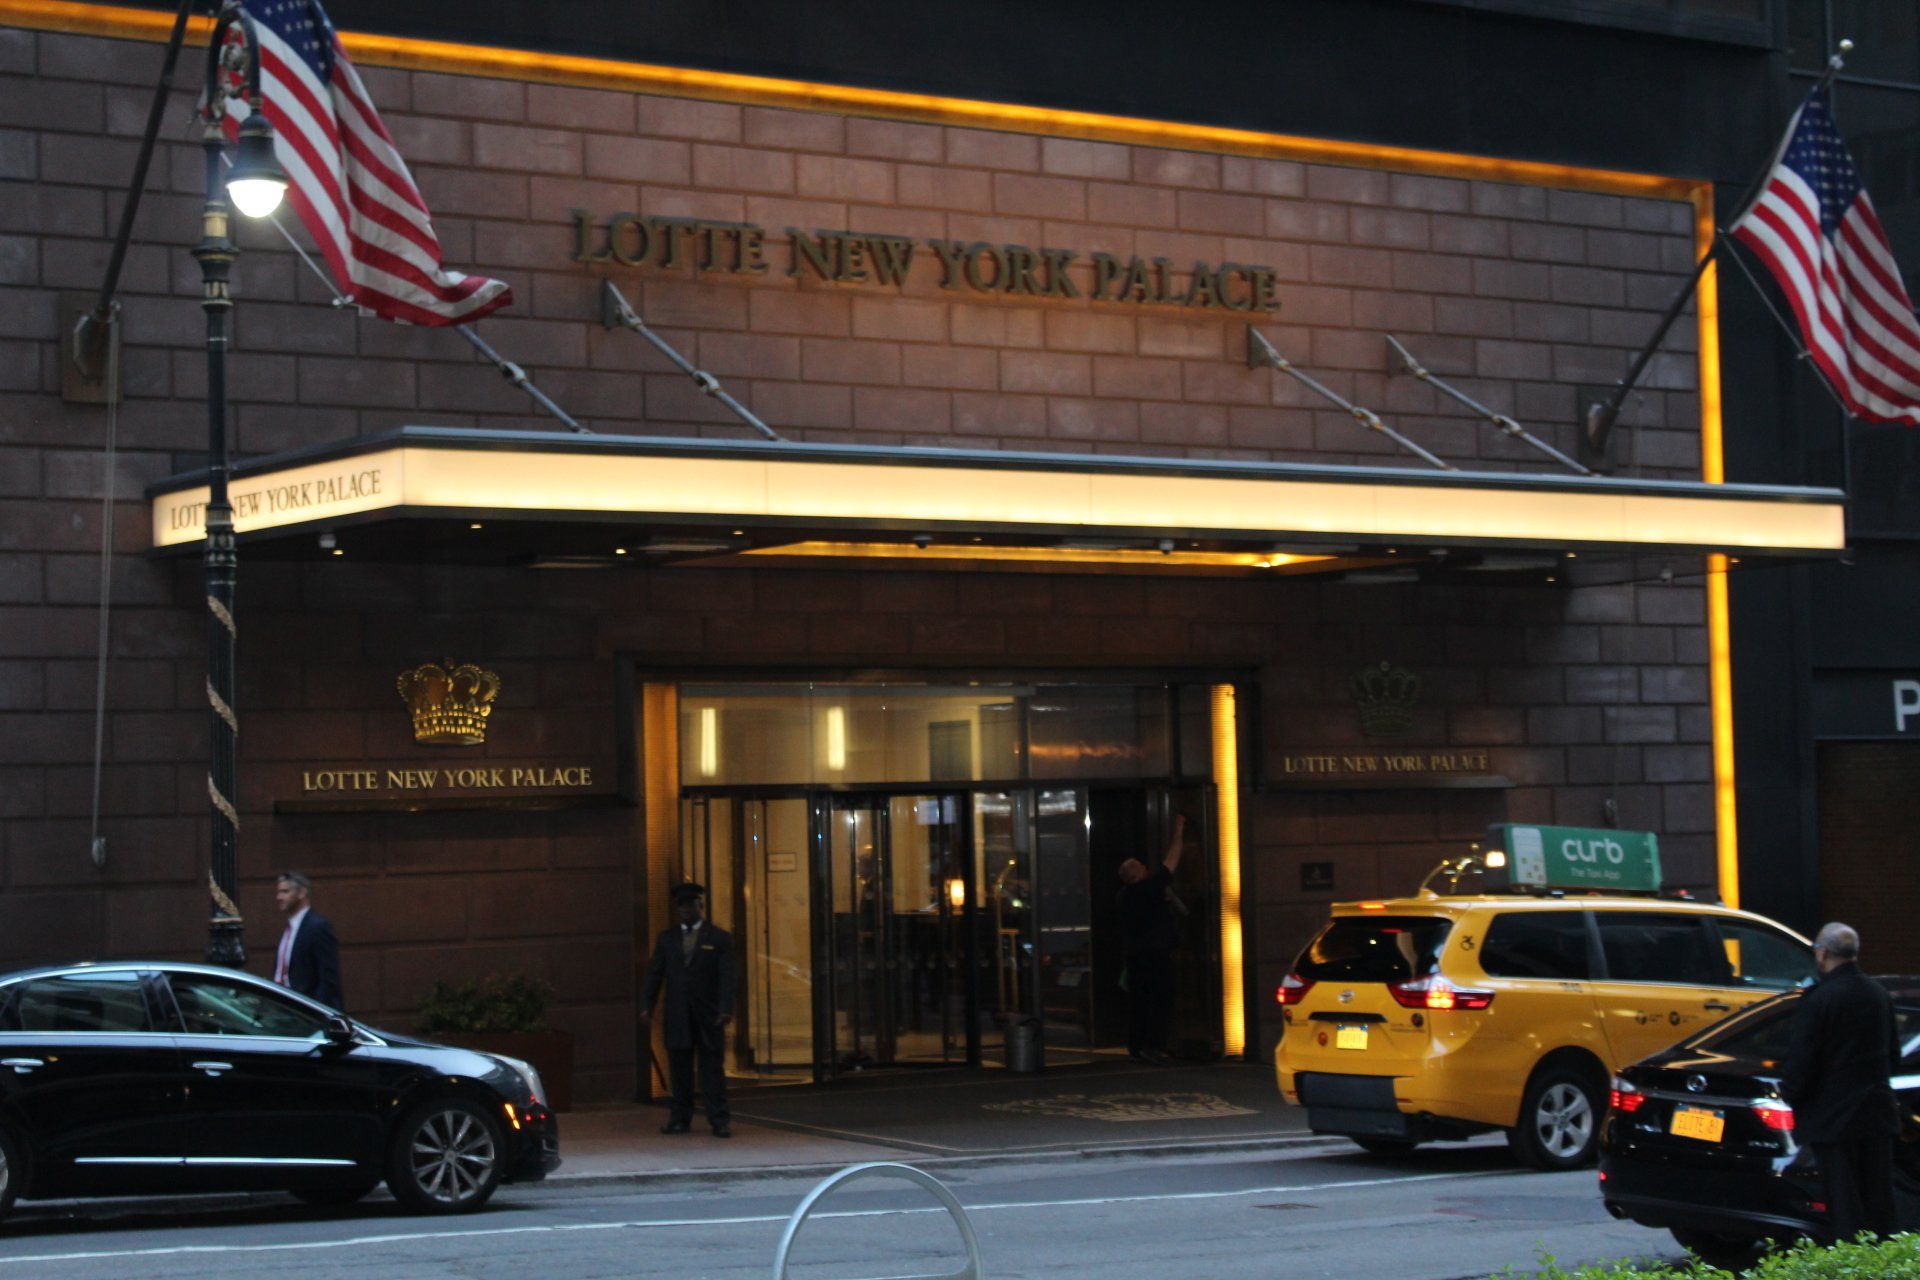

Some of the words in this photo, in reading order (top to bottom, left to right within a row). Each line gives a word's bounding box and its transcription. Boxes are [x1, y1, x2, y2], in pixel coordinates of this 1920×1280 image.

[572, 209, 769, 275] LOTTE
[785, 226, 917, 287] NEW
[926, 239, 1082, 299] YORK
[1091, 251, 1282, 313] PALACE
[266, 482, 315, 513] YORK
[316, 469, 382, 504] PALACE
[1284, 757, 1338, 773] LOTTE
[1343, 756, 1378, 772] NEW
[1383, 756, 1427, 771] YORK
[1430, 754, 1488, 771] PALACE
[303, 771, 379, 791] LOTTE
[386, 770, 438, 789] NEW
[444, 768, 505, 788] YORK
[511, 767, 593, 787] PALACE
[1561, 838, 1624, 864] curb
